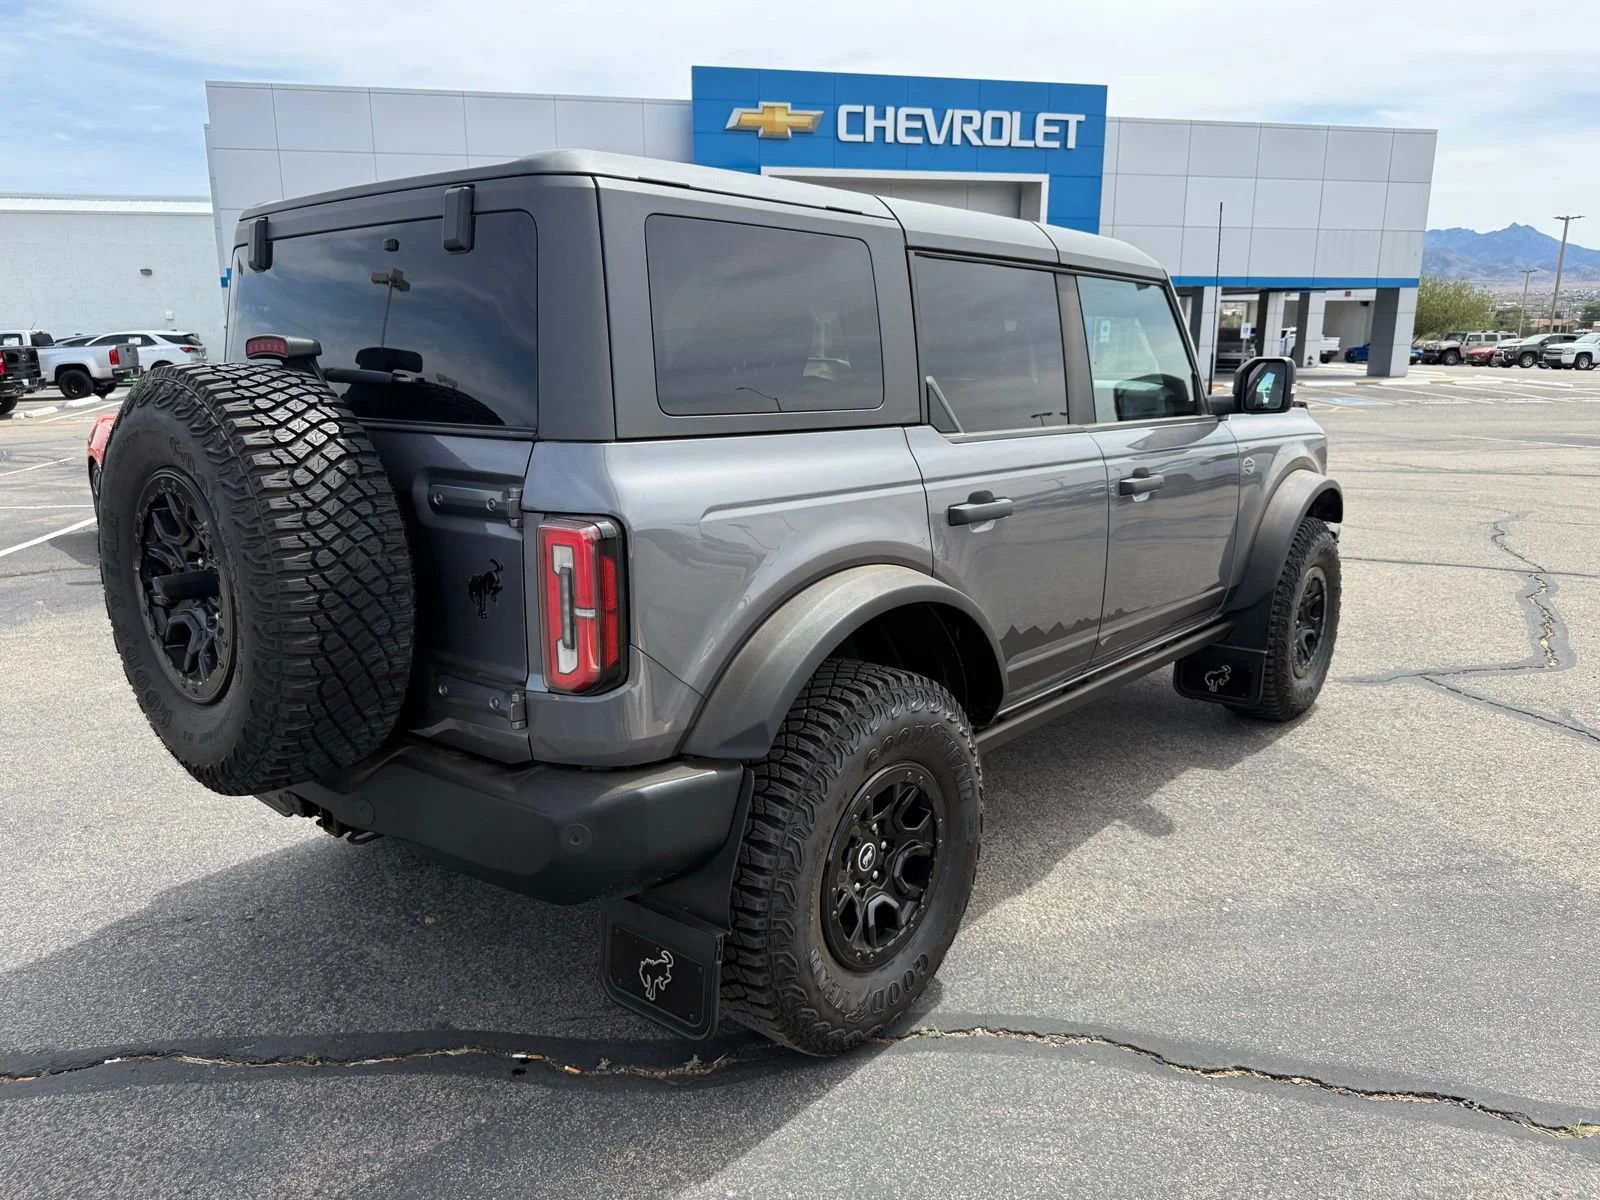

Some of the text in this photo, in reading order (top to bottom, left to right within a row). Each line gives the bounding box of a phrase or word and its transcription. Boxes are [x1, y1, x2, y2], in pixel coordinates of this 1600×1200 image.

[837, 104, 1086, 150] CHEVROLET
[863, 722, 974, 801] GOODYEAR
[810, 945, 930, 1023] GOODYEAR
